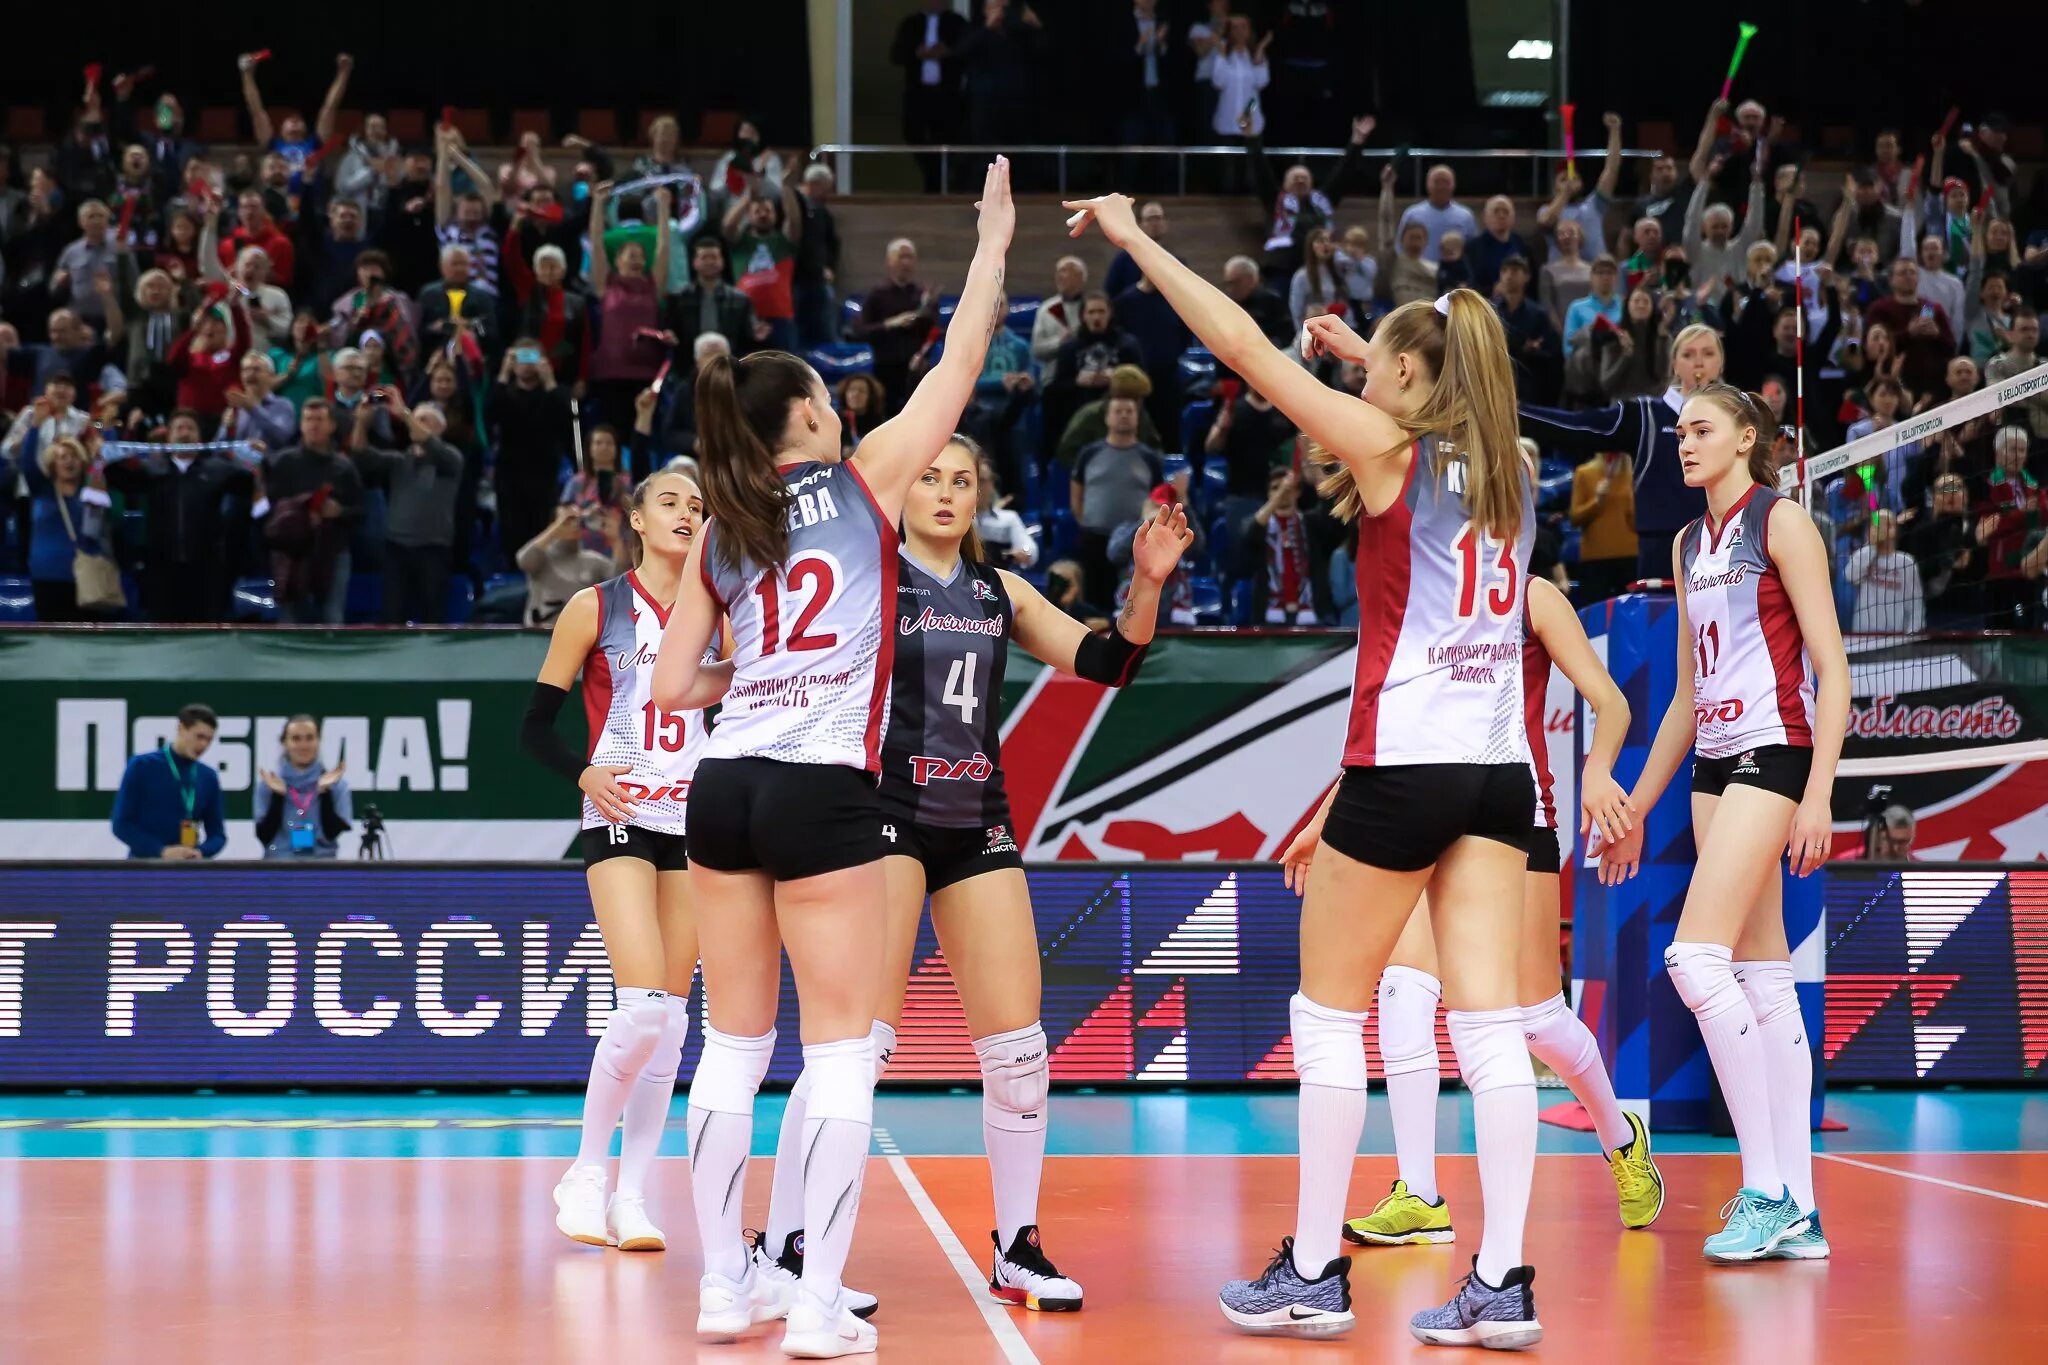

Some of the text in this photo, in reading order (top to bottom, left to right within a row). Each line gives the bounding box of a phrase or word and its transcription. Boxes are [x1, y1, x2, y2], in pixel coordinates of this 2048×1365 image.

[783, 486, 839, 533] ЕВА
[1454, 523, 1519, 619] 13
[755, 557, 838, 658] 12
[901, 605, 1003, 637] Локомотив
[1450, 664, 1496, 684] ОБЛАСТЬ
[1698, 620, 1719, 678] 11
[942, 651, 979, 724] 4
[642, 698, 685, 752] 15
[607, 824, 629, 845] 15
[881, 824, 898, 843] 4
[104, 916, 708, 1038] РОССИ
